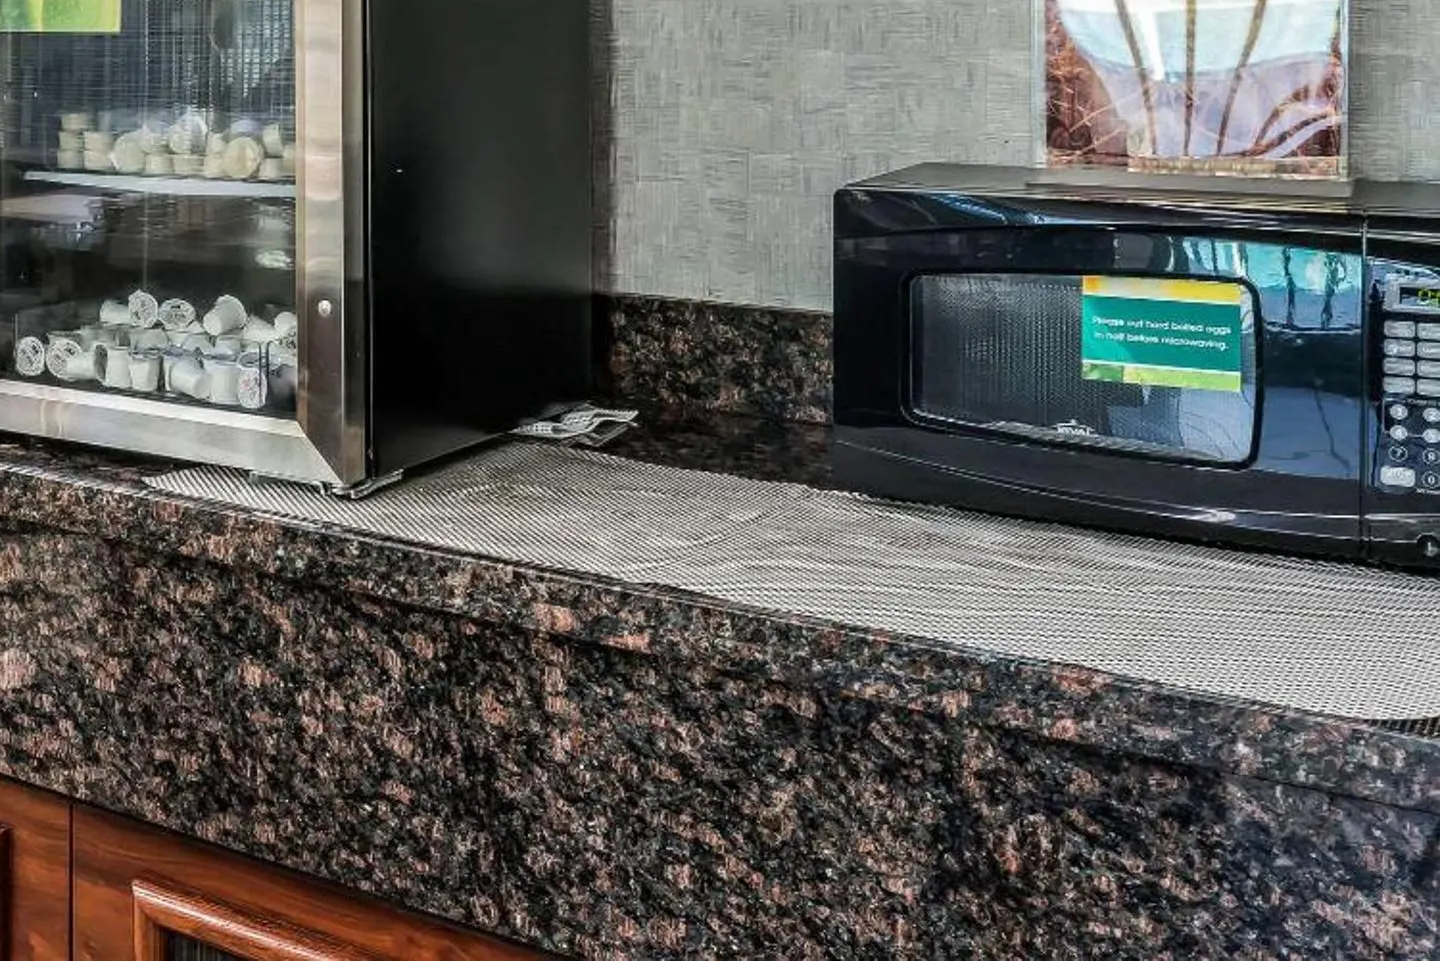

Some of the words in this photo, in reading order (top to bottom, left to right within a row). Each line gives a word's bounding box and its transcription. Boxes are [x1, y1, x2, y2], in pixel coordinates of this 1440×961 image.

[1145, 320, 1170, 331] hard
[1205, 325, 1232, 337] eggs
[1126, 332, 1160, 344] before
